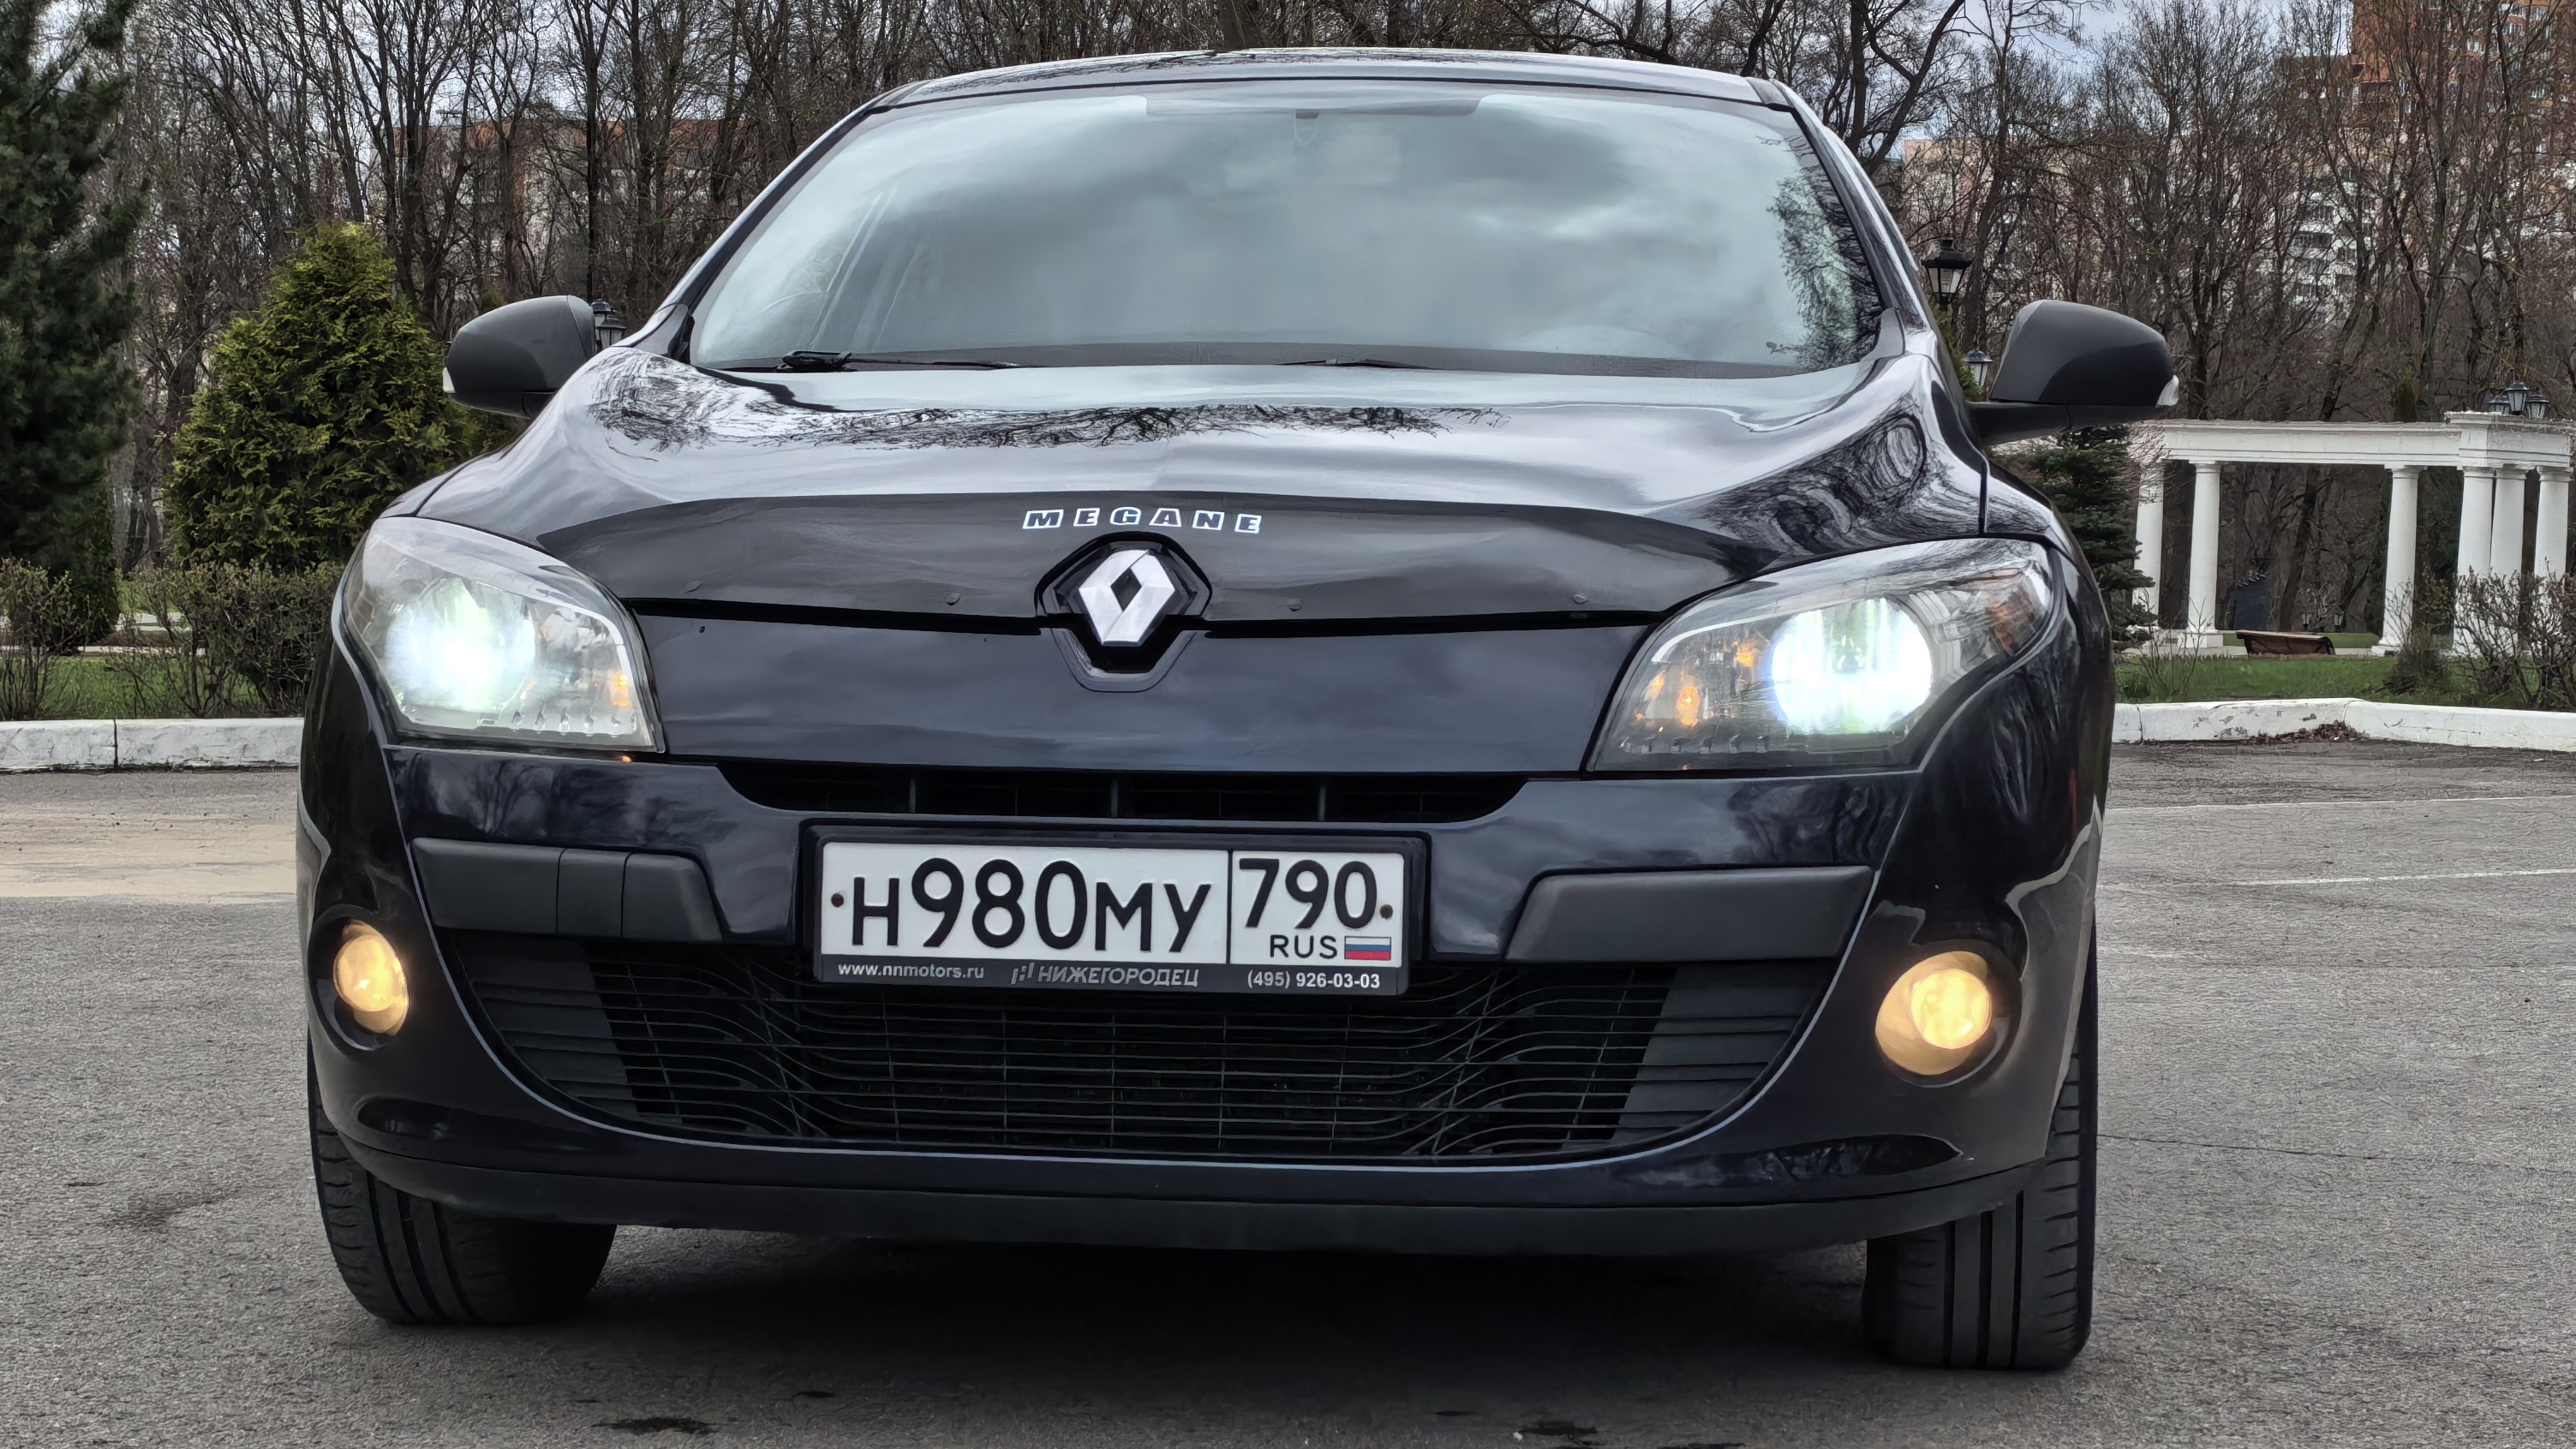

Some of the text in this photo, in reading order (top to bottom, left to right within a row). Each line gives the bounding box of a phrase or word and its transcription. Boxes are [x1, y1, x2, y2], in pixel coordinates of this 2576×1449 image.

[1022, 506, 1262, 534] MEGANE
[1239, 858, 1378, 929] 790
[1269, 934, 1338, 960] RUS
[838, 962, 984, 980] www.nnmotors.ru
[1037, 966, 1198, 987] НИЖЕГОРОДЕЦ
[1247, 970, 1381, 990] (495) 926-03-03
